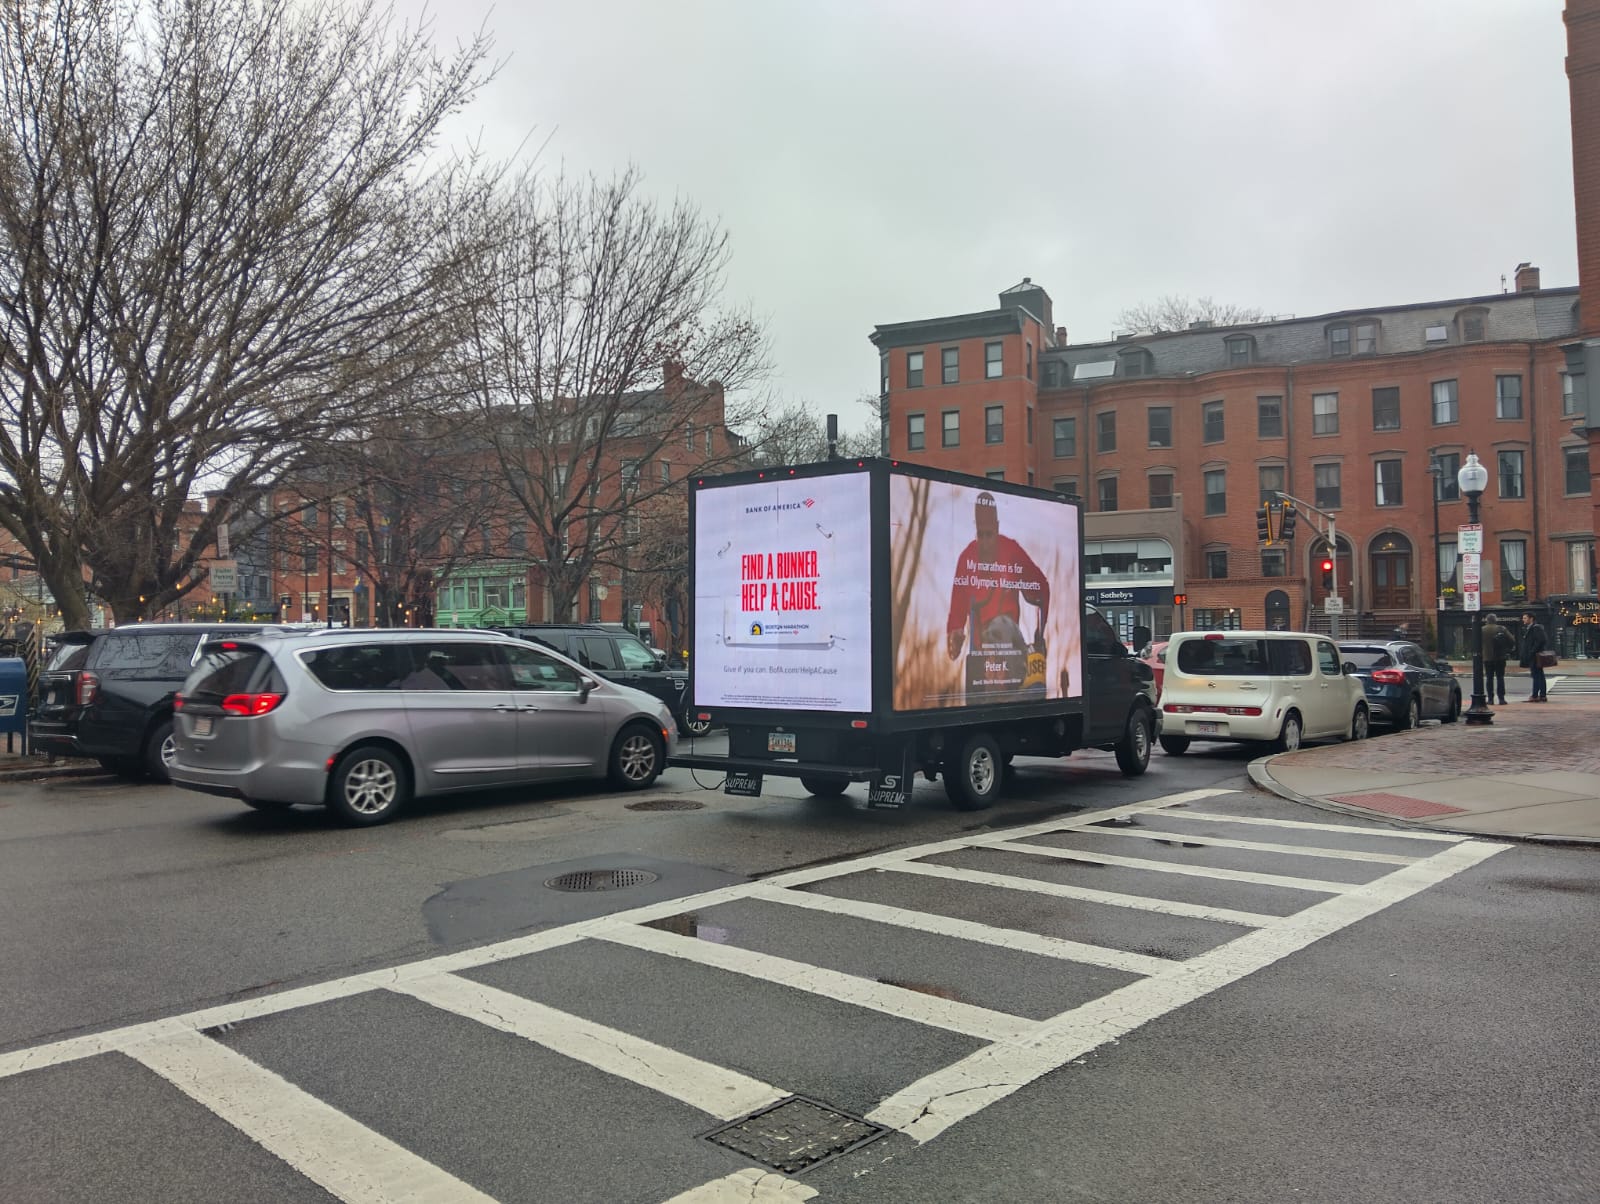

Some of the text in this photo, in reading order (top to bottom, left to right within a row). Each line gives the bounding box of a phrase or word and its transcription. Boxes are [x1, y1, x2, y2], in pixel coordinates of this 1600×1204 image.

[772, 503, 801, 511] AMERICA
[742, 550, 820, 580] FIND A RUNNER.
[967, 560, 1023, 574] My marathon is for
[953, 575, 1041, 590] ecial Olympics Massachusetts
[742, 581, 821, 611] HELP A CAUSE.
[1100, 591, 1134, 600] Sotheby's
[724, 665, 737, 673] Give
[737, 665, 742, 673] if
[743, 666, 754, 675] you
[985, 661, 1001, 672] Peter
[725, 777, 757, 790] SUPREME
[869, 790, 905, 804] SUPREME
